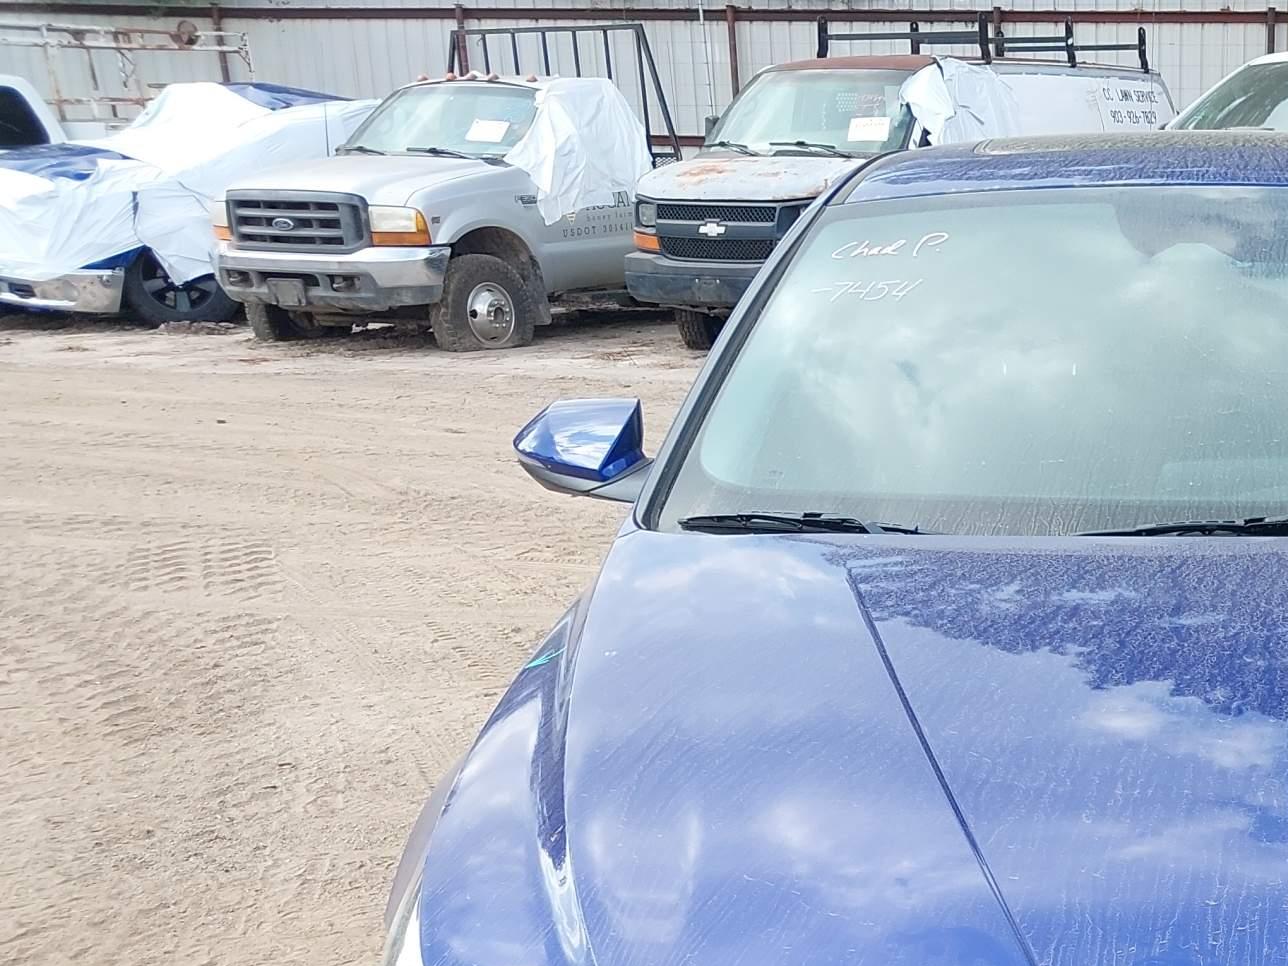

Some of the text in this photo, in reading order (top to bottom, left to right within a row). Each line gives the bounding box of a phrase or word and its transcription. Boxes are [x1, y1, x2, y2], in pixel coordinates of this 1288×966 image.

[1102, 87, 1158, 104] CC LAWN SERVICE
[562, 225, 597, 238] USDOT
